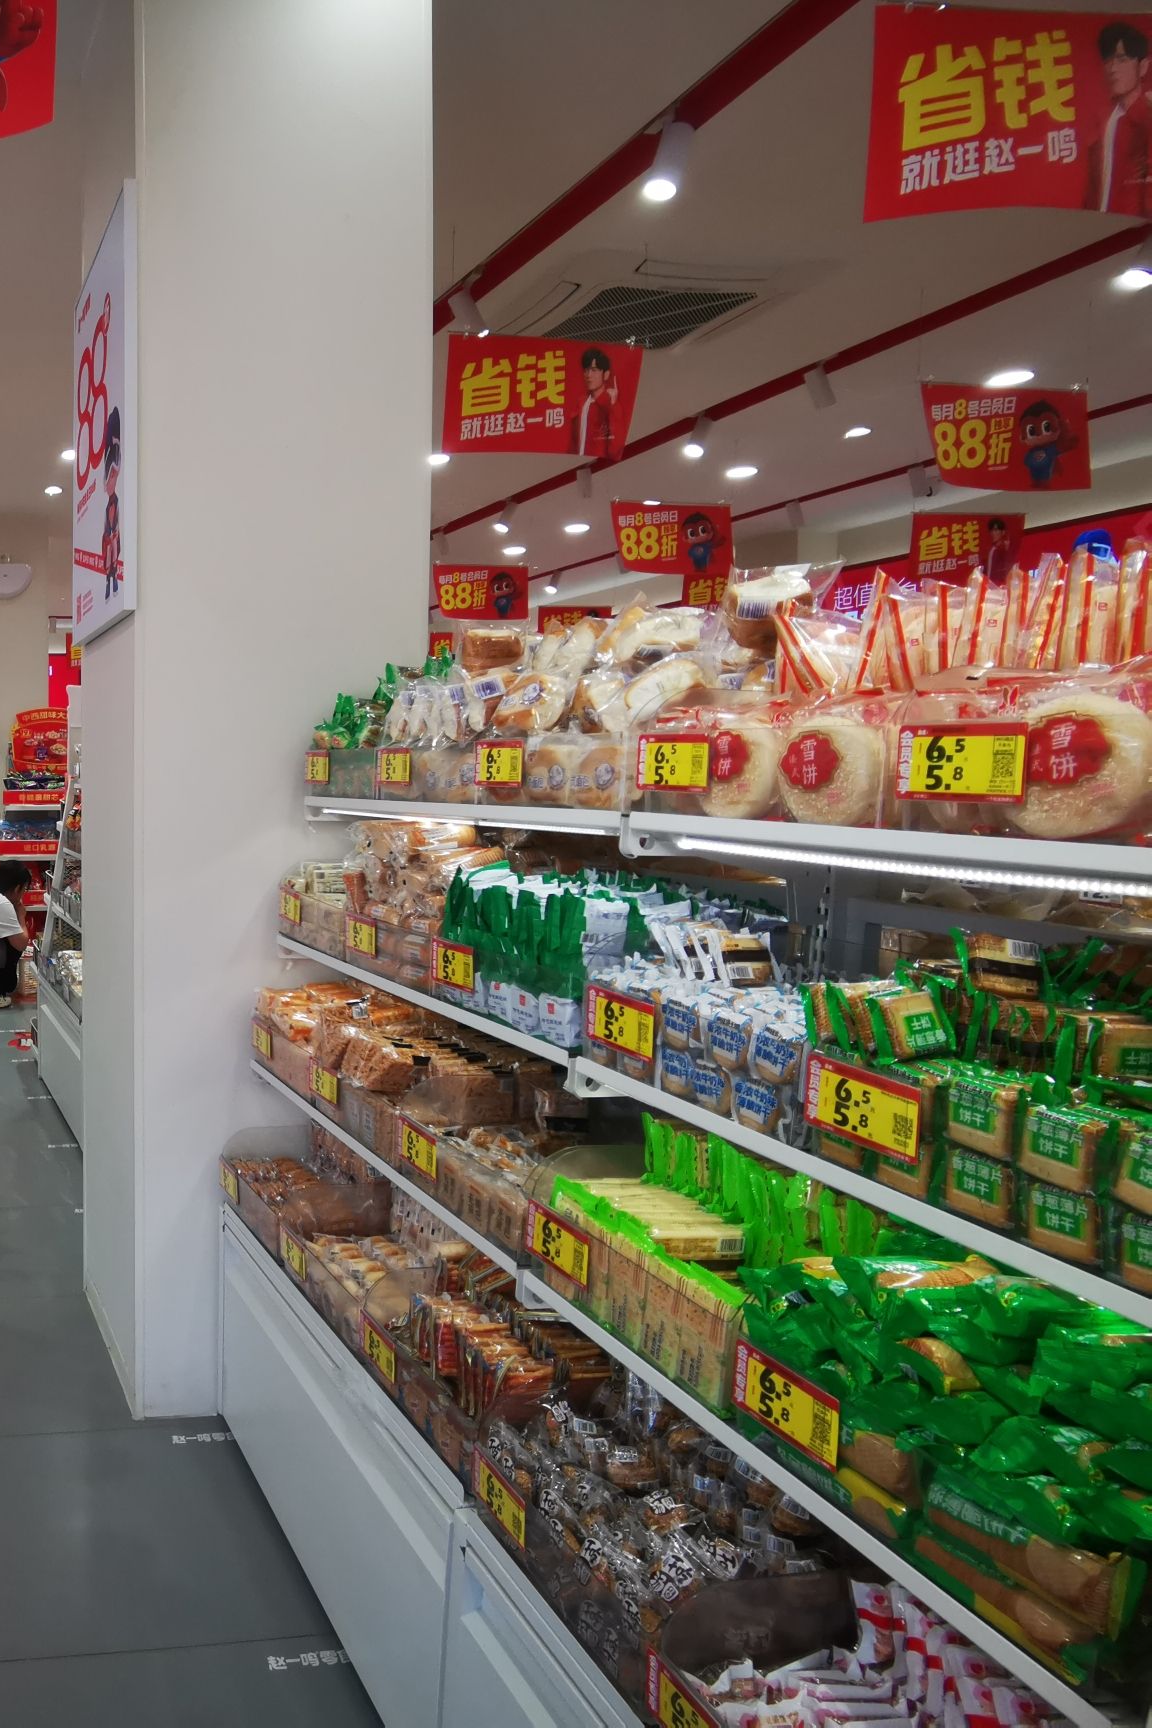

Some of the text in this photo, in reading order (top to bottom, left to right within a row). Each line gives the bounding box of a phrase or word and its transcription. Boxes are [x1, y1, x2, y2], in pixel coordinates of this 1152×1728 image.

[899, 30, 1076, 151] 省钱
[900, 127, 1077, 195] 就逛赵一鸣
[460, 350, 565, 416] 省钱
[932, 397, 1016, 421] 每月8号会员日
[460, 408, 565, 440] 就逛赵一鸣
[618, 511, 678, 528] 每月8号会员日
[919, 521, 979, 561] 省钱
[22, 711, 67, 722] 中西甜味大
[486, 749, 501, 764] 6.5
[655, 744, 677, 764] 6.5
[717, 735, 732, 776] 雪饼
[800, 739, 818, 785] 雪饼
[926, 736, 966, 763] 6.5
[1050, 722, 1077, 779] 雪饼
[654, 765, 676, 785] 5.8
[925, 764, 964, 791] 5.8
[443, 949, 456, 965] 6.5
[604, 1001, 625, 1022] 6.5
[603, 1022, 624, 1043] 5.8
[835, 1077, 871, 1107] 6.5
[833, 1101, 869, 1132] 5.8
[959, 1107, 985, 1126] 饼干
[1039, 1138, 1068, 1159] 饼干
[963, 1176, 989, 1196] 饼干
[542, 1219, 562, 1244] 6.5
[1046, 1211, 1074, 1233] 饼干
[542, 1238, 561, 1263] 5.8
[759, 1367, 791, 1400] 6.5
[758, 1396, 790, 1426] 5.8
